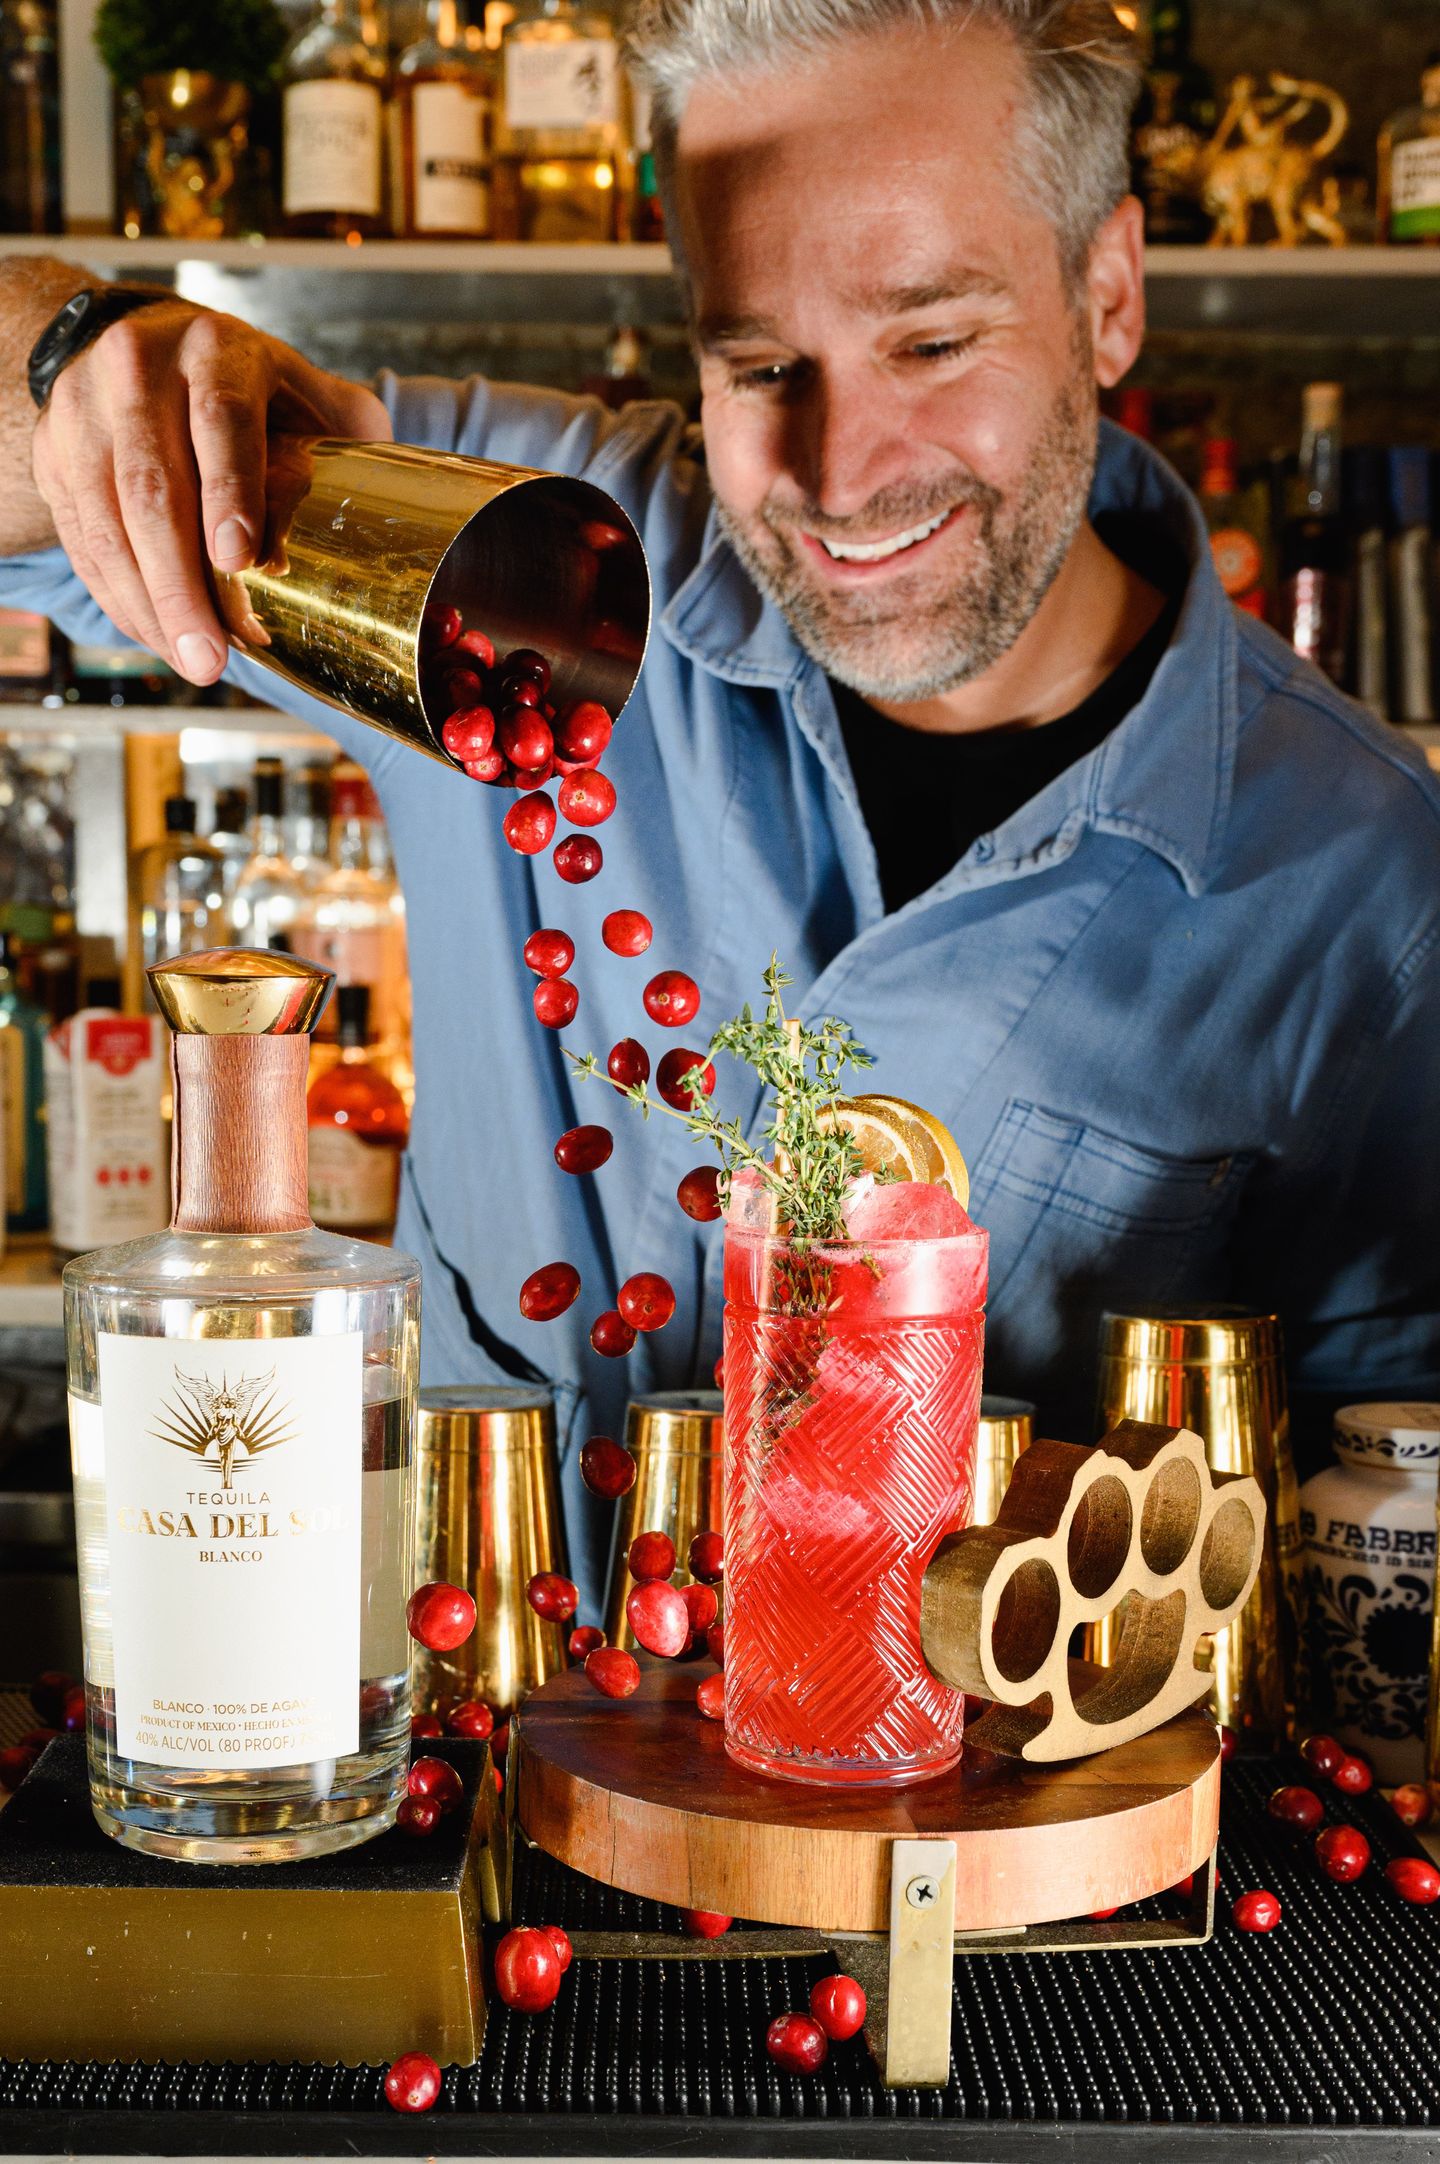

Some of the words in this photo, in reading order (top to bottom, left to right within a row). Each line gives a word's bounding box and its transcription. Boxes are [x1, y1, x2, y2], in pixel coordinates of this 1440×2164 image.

[186, 1492, 271, 1505] TEQUILA
[117, 1506, 199, 1538] CASA
[209, 1512, 279, 1539] DEL
[289, 1504, 350, 1536] SOL
[199, 1551, 263, 1563] BLANCO
[152, 1699, 204, 1714] BLANCO
[213, 1703, 247, 1715] 100%
[250, 1702, 269, 1714] DE
[140, 1714, 181, 1729] PRODUCT
[182, 1720, 196, 1730] OF
[197, 1721, 236, 1732] MEXICO
[244, 1720, 280, 1731] HECHO
[136, 1731, 159, 1747] 40%
[161, 1735, 215, 1753] ALC/VOL
[218, 1737, 241, 1753] (80
[245, 1735, 296, 1752] PROOF)
